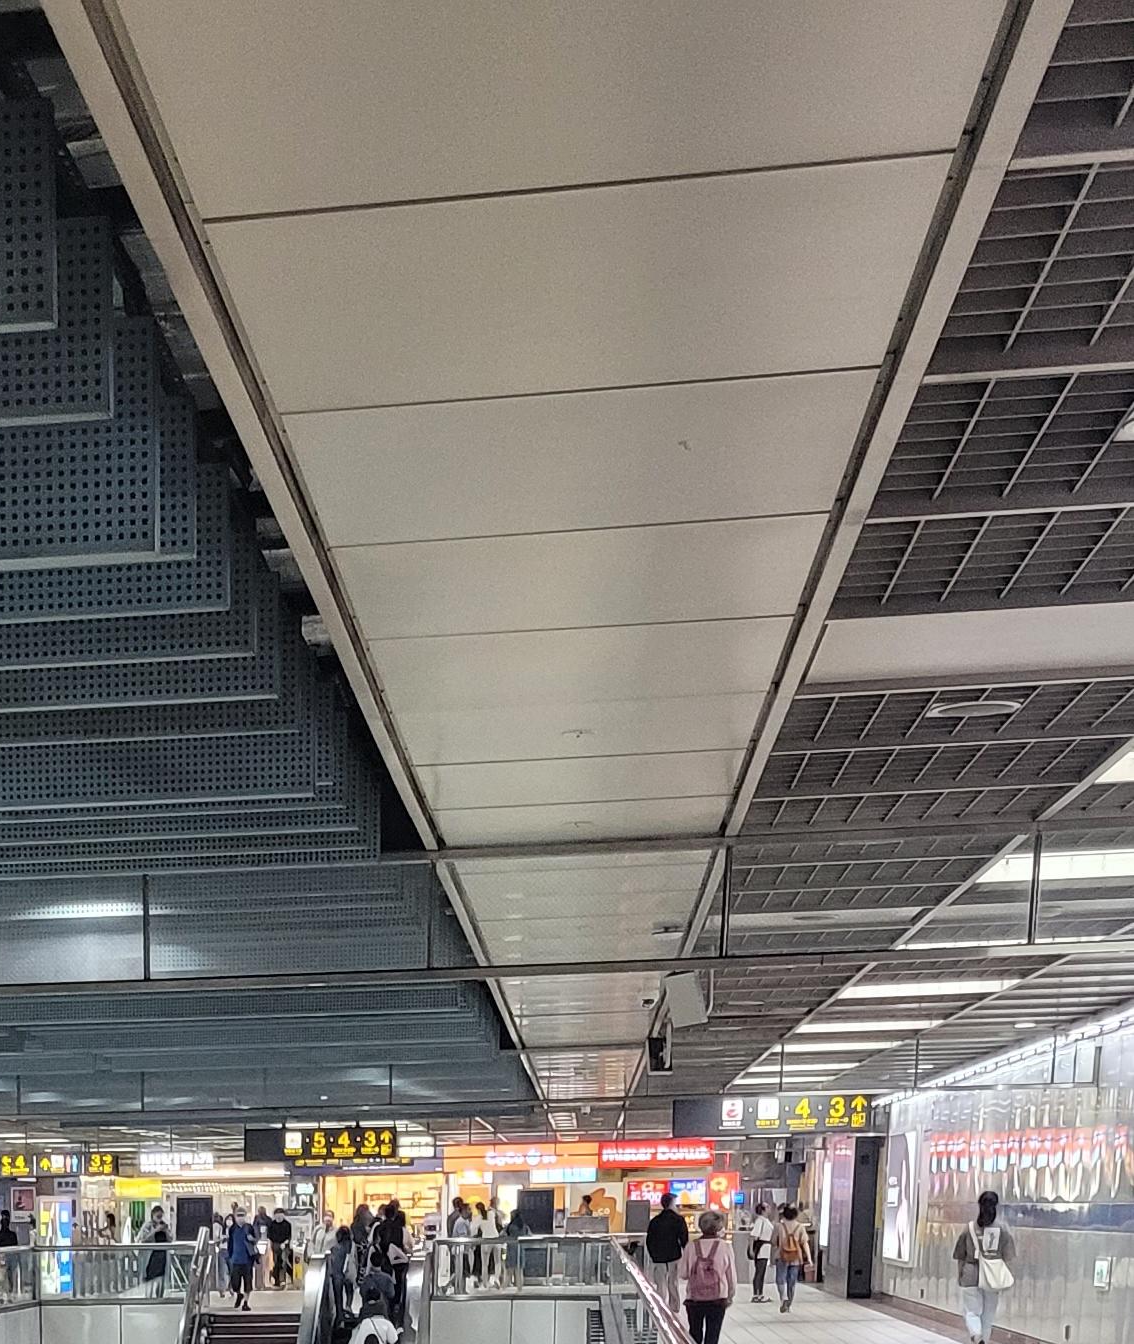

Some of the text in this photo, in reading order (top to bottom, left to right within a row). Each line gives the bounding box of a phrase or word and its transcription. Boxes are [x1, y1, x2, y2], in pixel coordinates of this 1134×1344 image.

[795, 1097, 845, 1118] 4 3
[312, 1131, 377, 1148] 5 4 3
[15, 1154, 28, 1168] 4
[89, 1154, 101, 1167] 3
